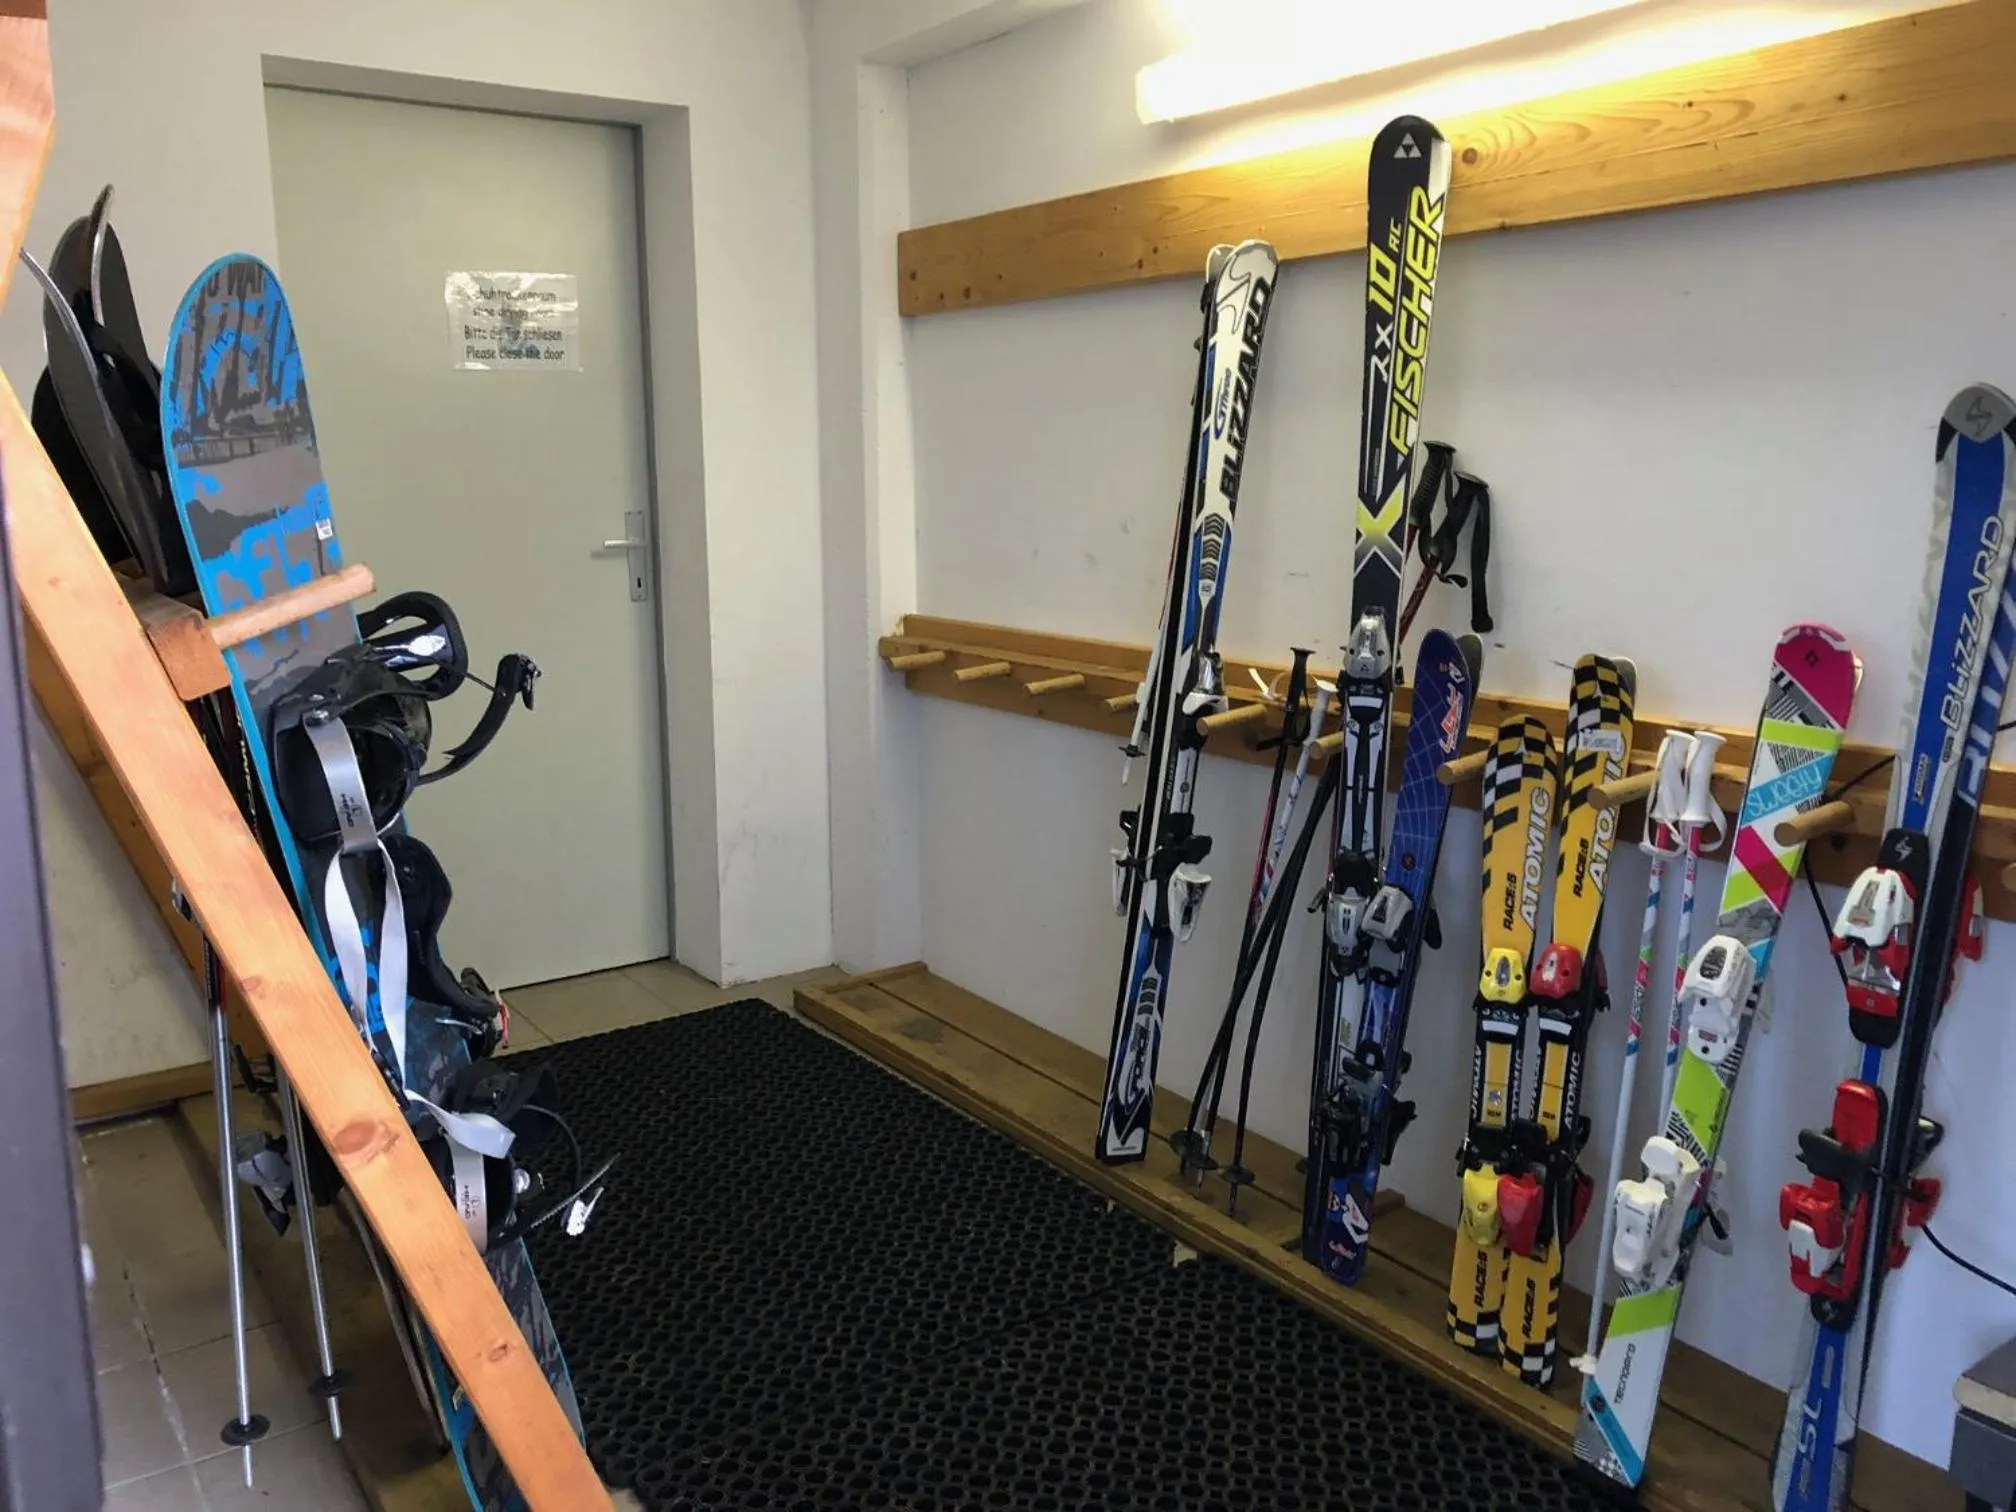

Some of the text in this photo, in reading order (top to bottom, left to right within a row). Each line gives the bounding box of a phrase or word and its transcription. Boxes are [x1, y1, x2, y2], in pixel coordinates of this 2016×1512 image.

[1368, 243, 1398, 317] 10
[464, 325, 487, 341] Bitte
[466, 345, 497, 361] Please
[543, 346, 565, 361] door
[1388, 185, 1446, 457] FISCHER
[1519, 786, 1550, 933] ATOMIC
[1564, 1051, 1581, 1130] ATOMIC
